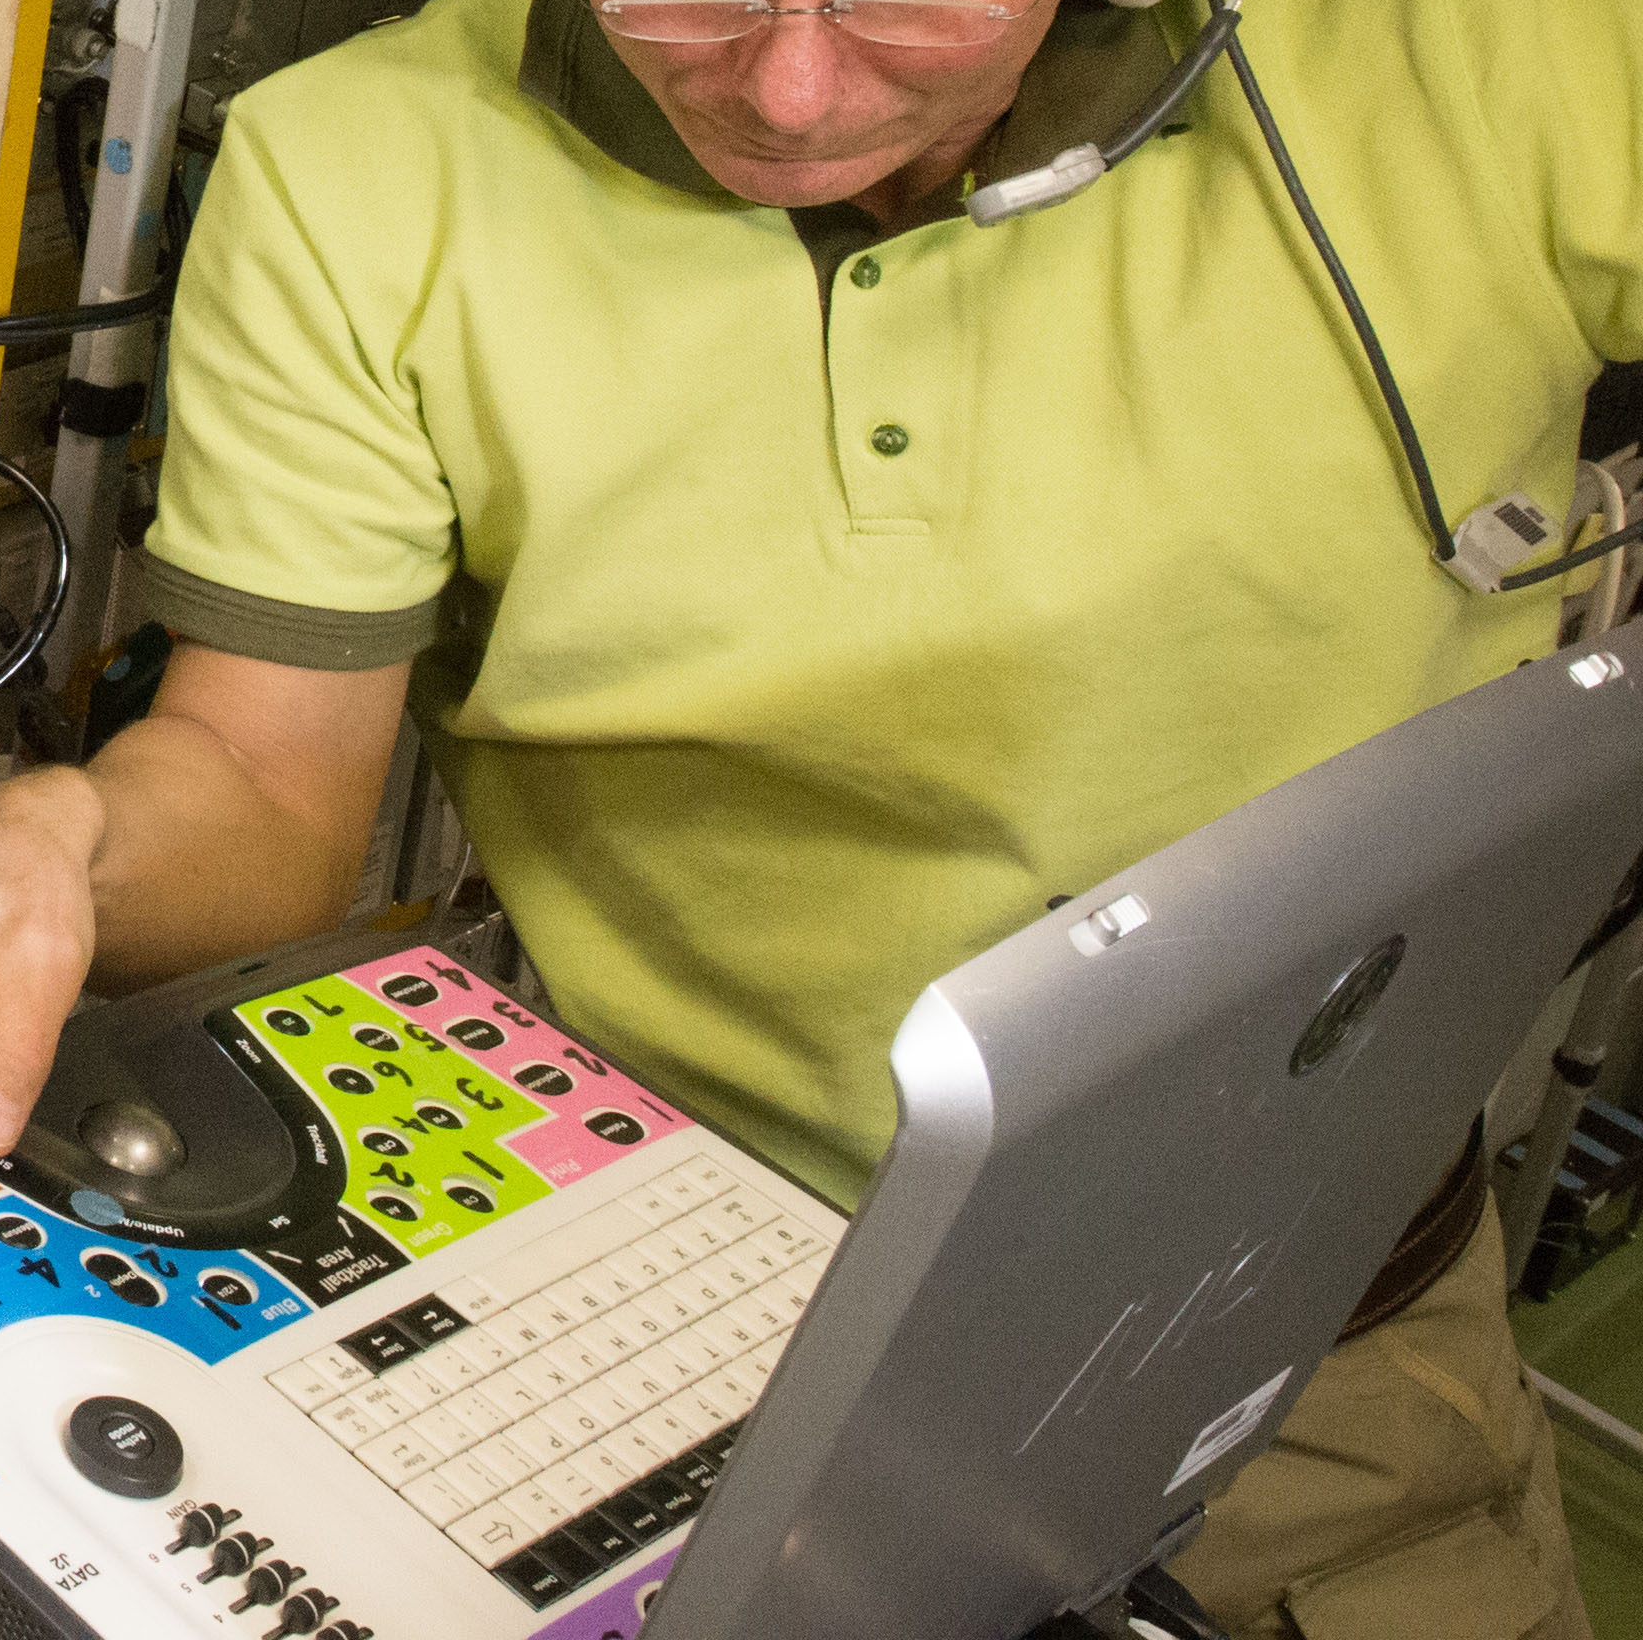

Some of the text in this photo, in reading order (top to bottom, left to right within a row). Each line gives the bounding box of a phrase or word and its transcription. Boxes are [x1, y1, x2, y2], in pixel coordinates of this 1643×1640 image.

[407, 1219, 453, 1249] Green
[317, 1246, 354, 1270] Area
[319, 1253, 389, 1293] Trackball
[260, 1296, 300, 1322] Blue
[108, 1422, 136, 1443] mode
[116, 1429, 147, 1452] Active
[166, 1499, 198, 1519] GAIN
[57, 1560, 98, 1591] DATA
